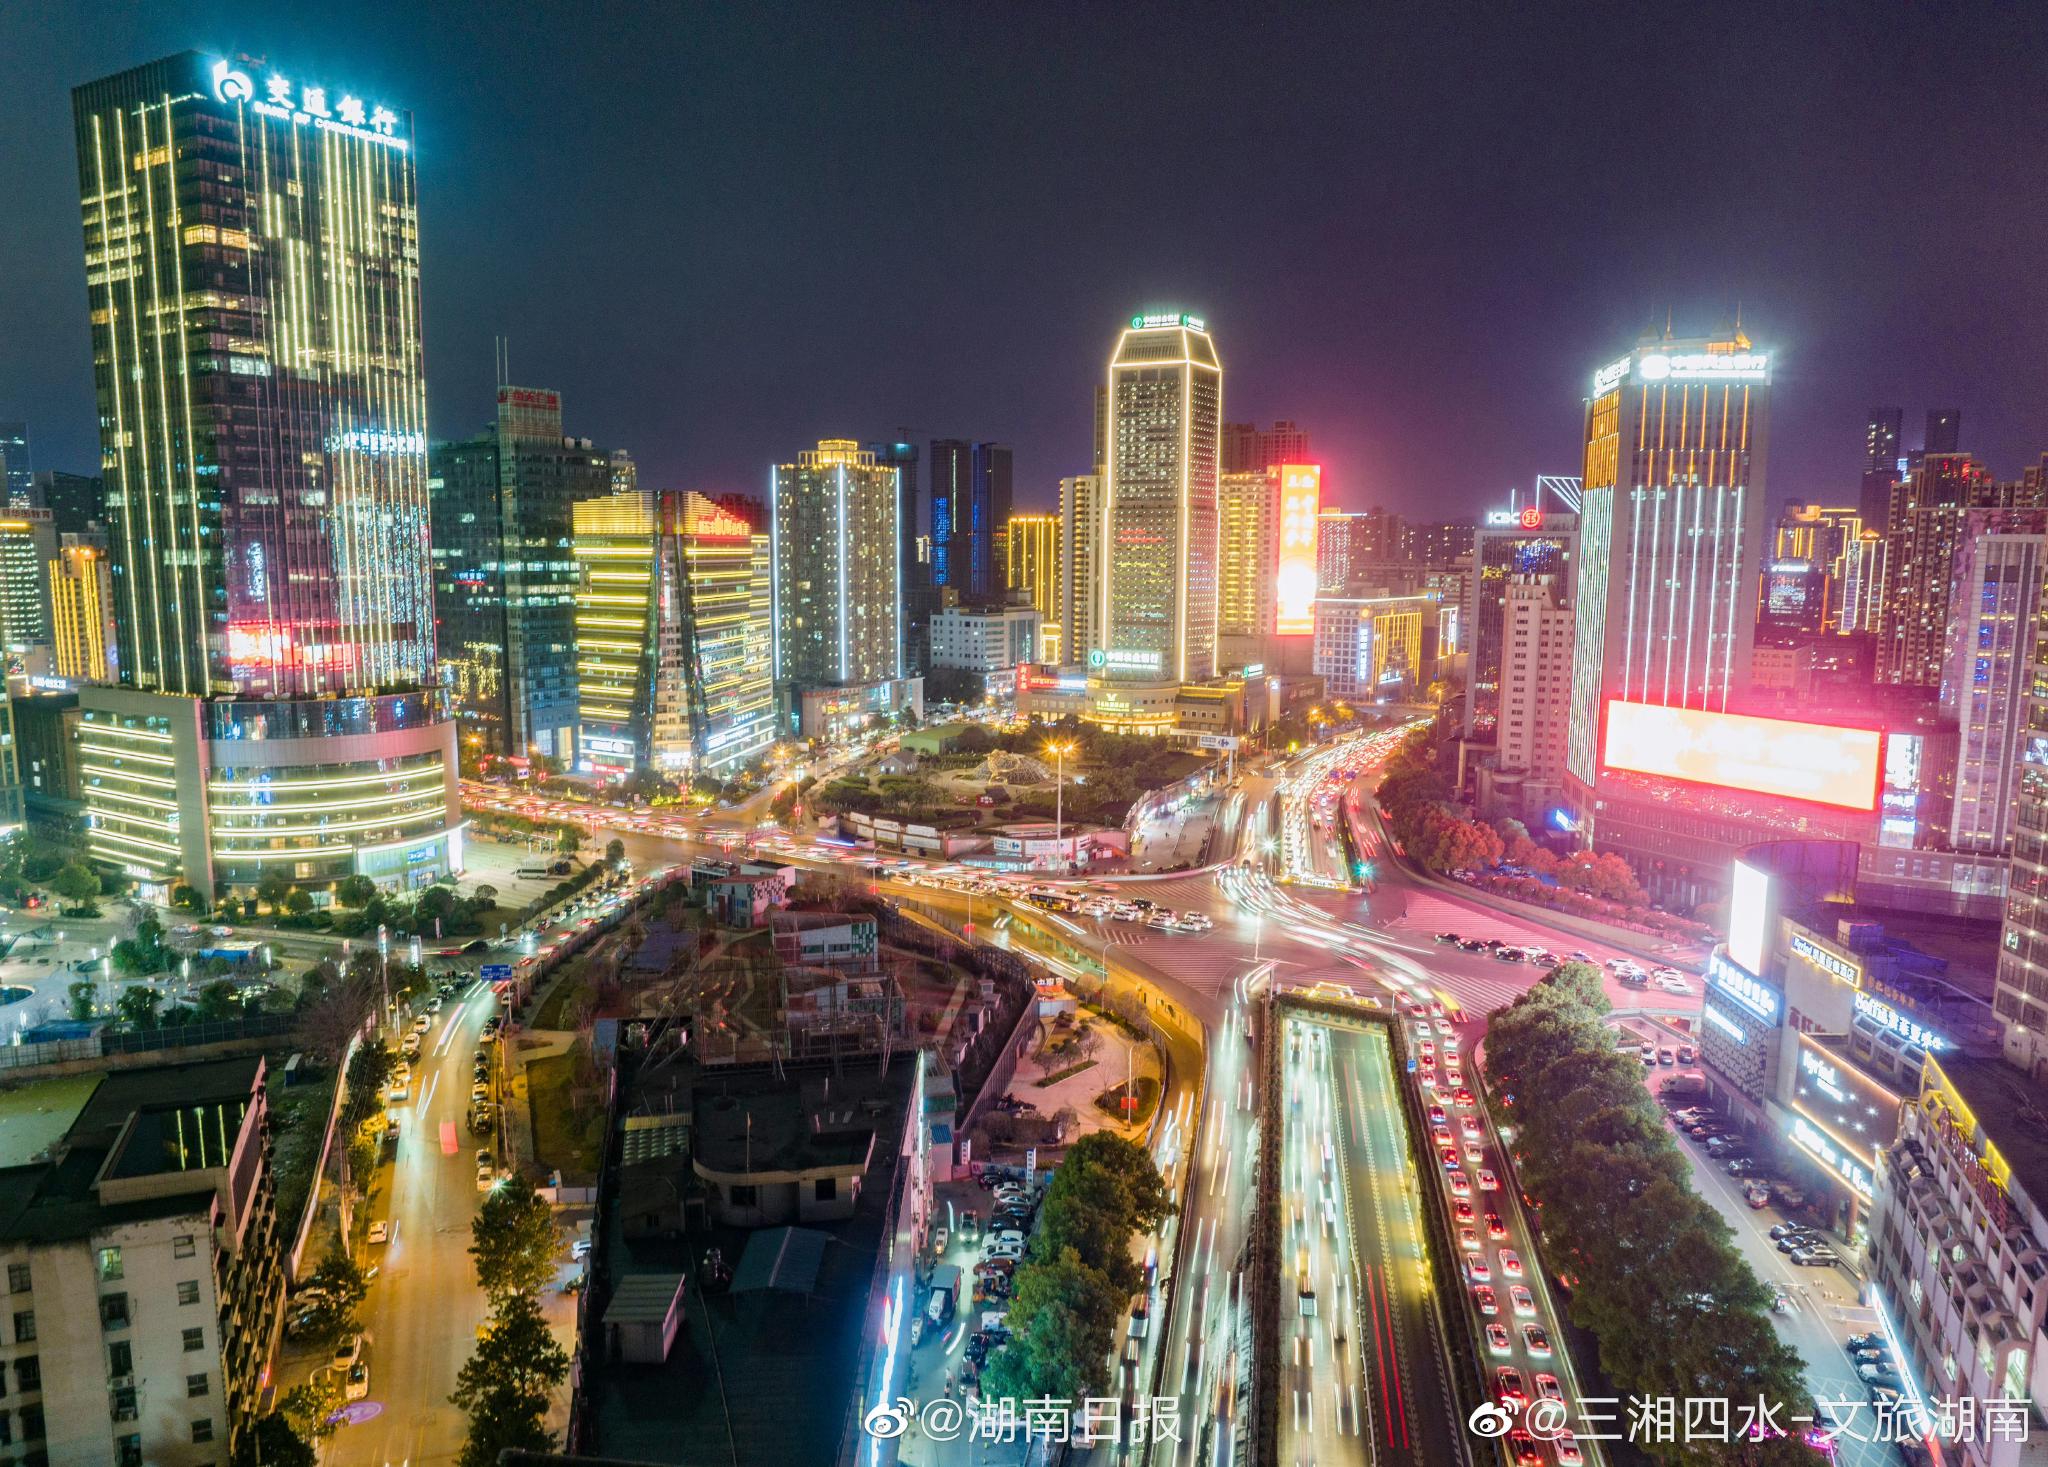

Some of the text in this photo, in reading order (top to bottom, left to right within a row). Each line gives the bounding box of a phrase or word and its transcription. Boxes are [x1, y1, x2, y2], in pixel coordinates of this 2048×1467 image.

[267, 75, 398, 135] 交通银行
[1488, 511, 1520, 524] ICBC
